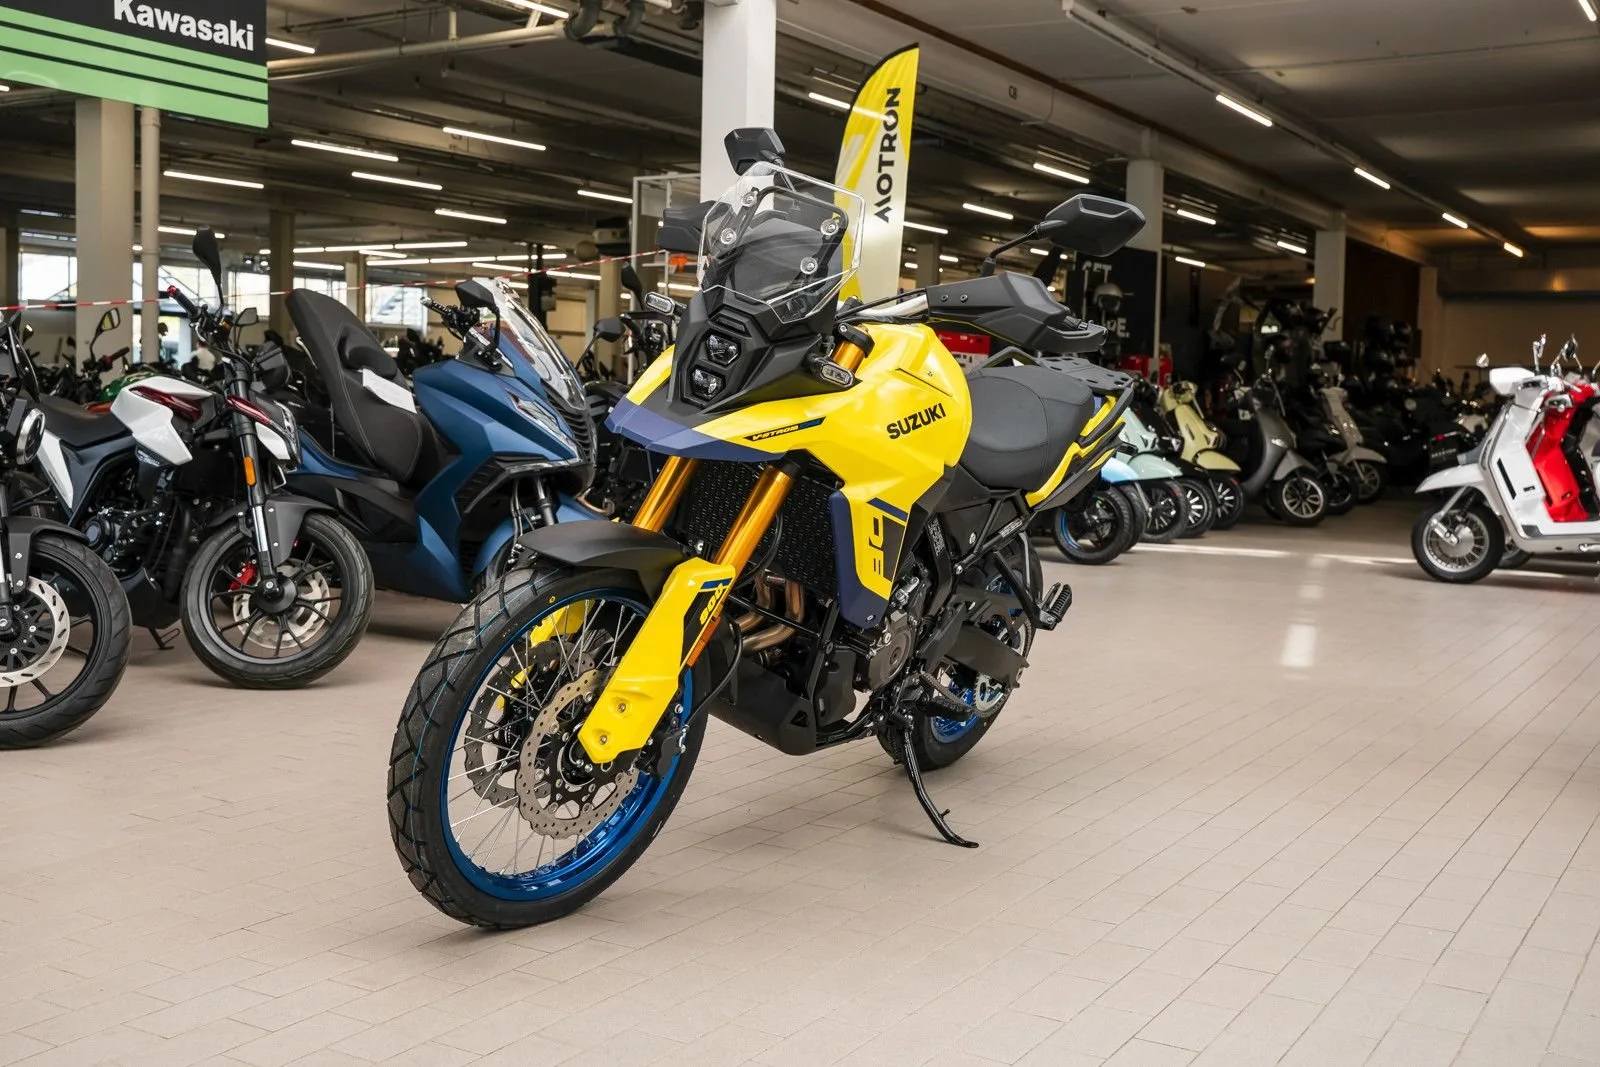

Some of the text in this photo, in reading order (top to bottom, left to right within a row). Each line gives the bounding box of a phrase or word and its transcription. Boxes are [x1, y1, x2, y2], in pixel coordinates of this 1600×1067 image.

[114, 0, 254, 51] Kawasaki
[874, 87, 901, 223] MOTRON
[886, 402, 946, 440] SUZUKI
